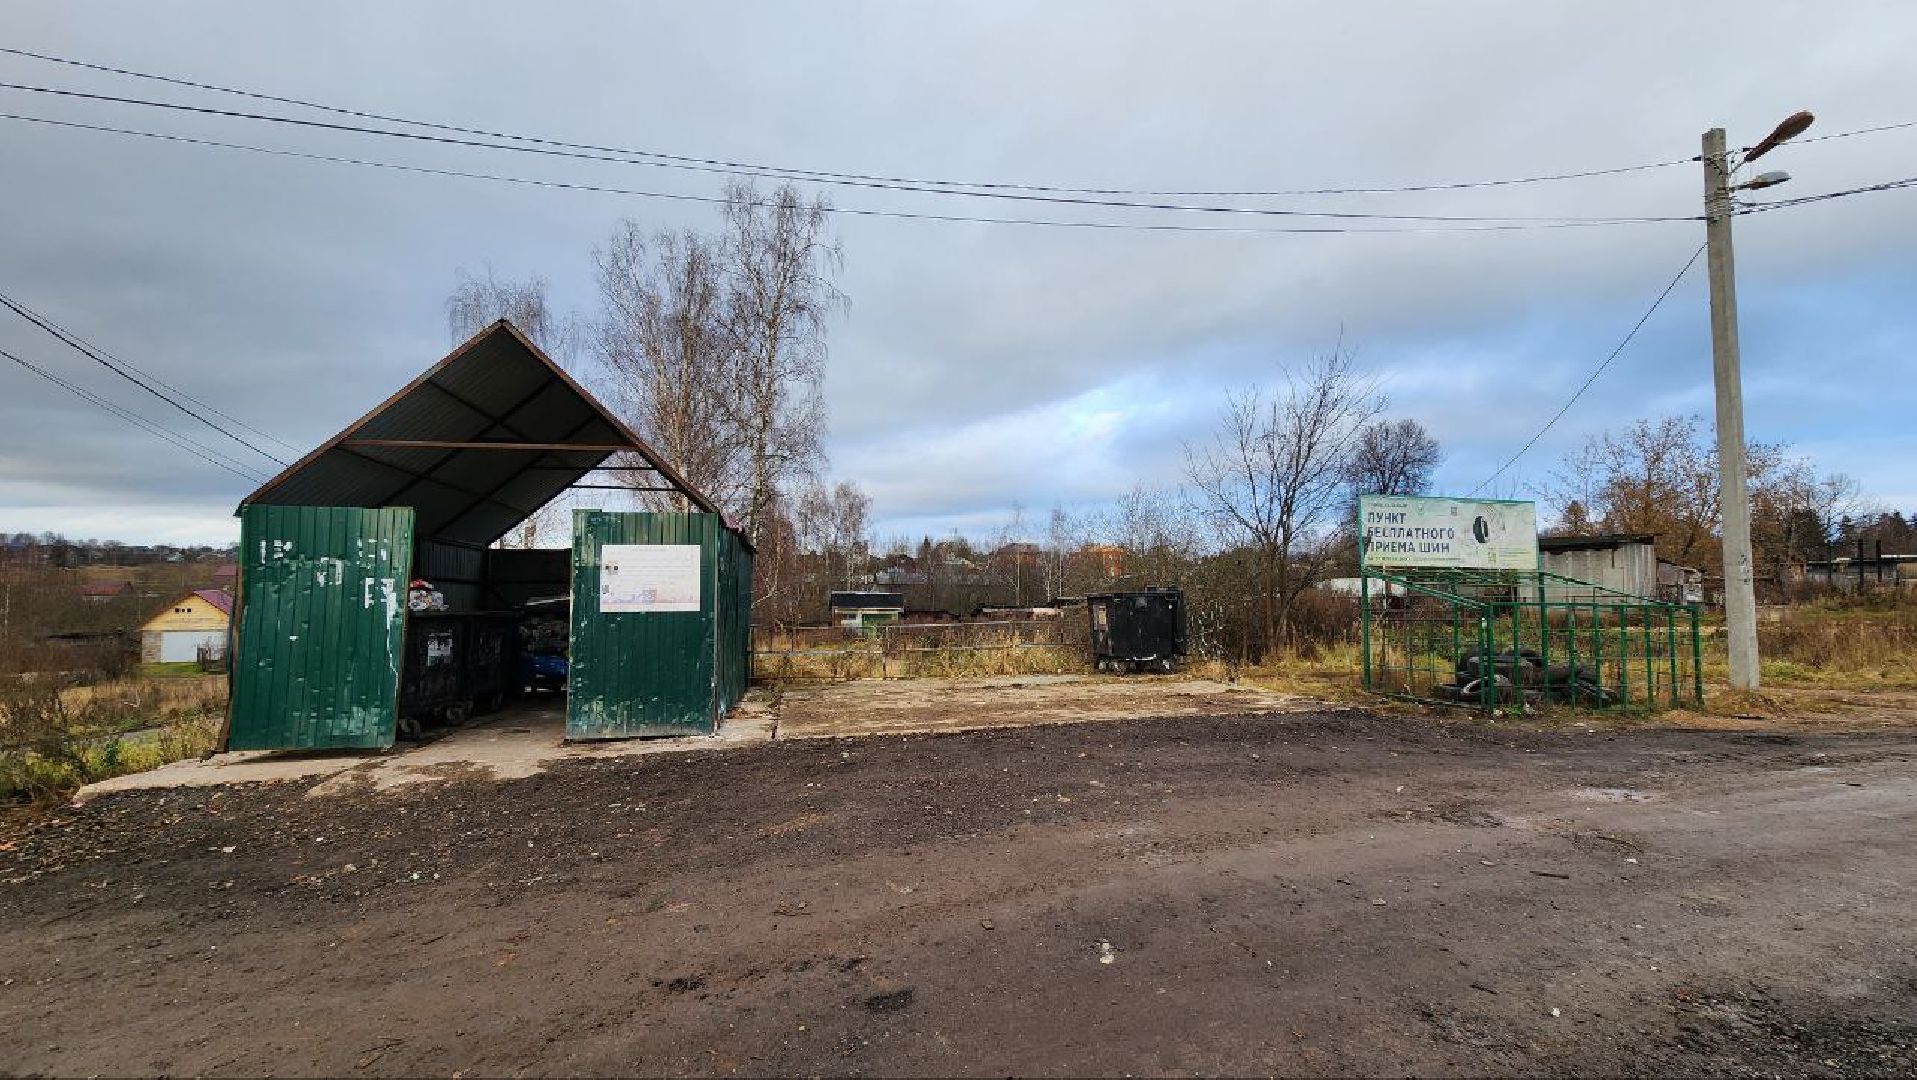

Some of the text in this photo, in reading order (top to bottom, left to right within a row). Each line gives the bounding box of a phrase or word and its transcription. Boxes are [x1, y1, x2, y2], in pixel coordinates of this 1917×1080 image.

[1367, 512, 1407, 525] ПУНКТ
[1367, 526, 1455, 540] БЕСПЛАТНОГО
[1368, 541, 1450, 553] ПРИЕМА ШИН
